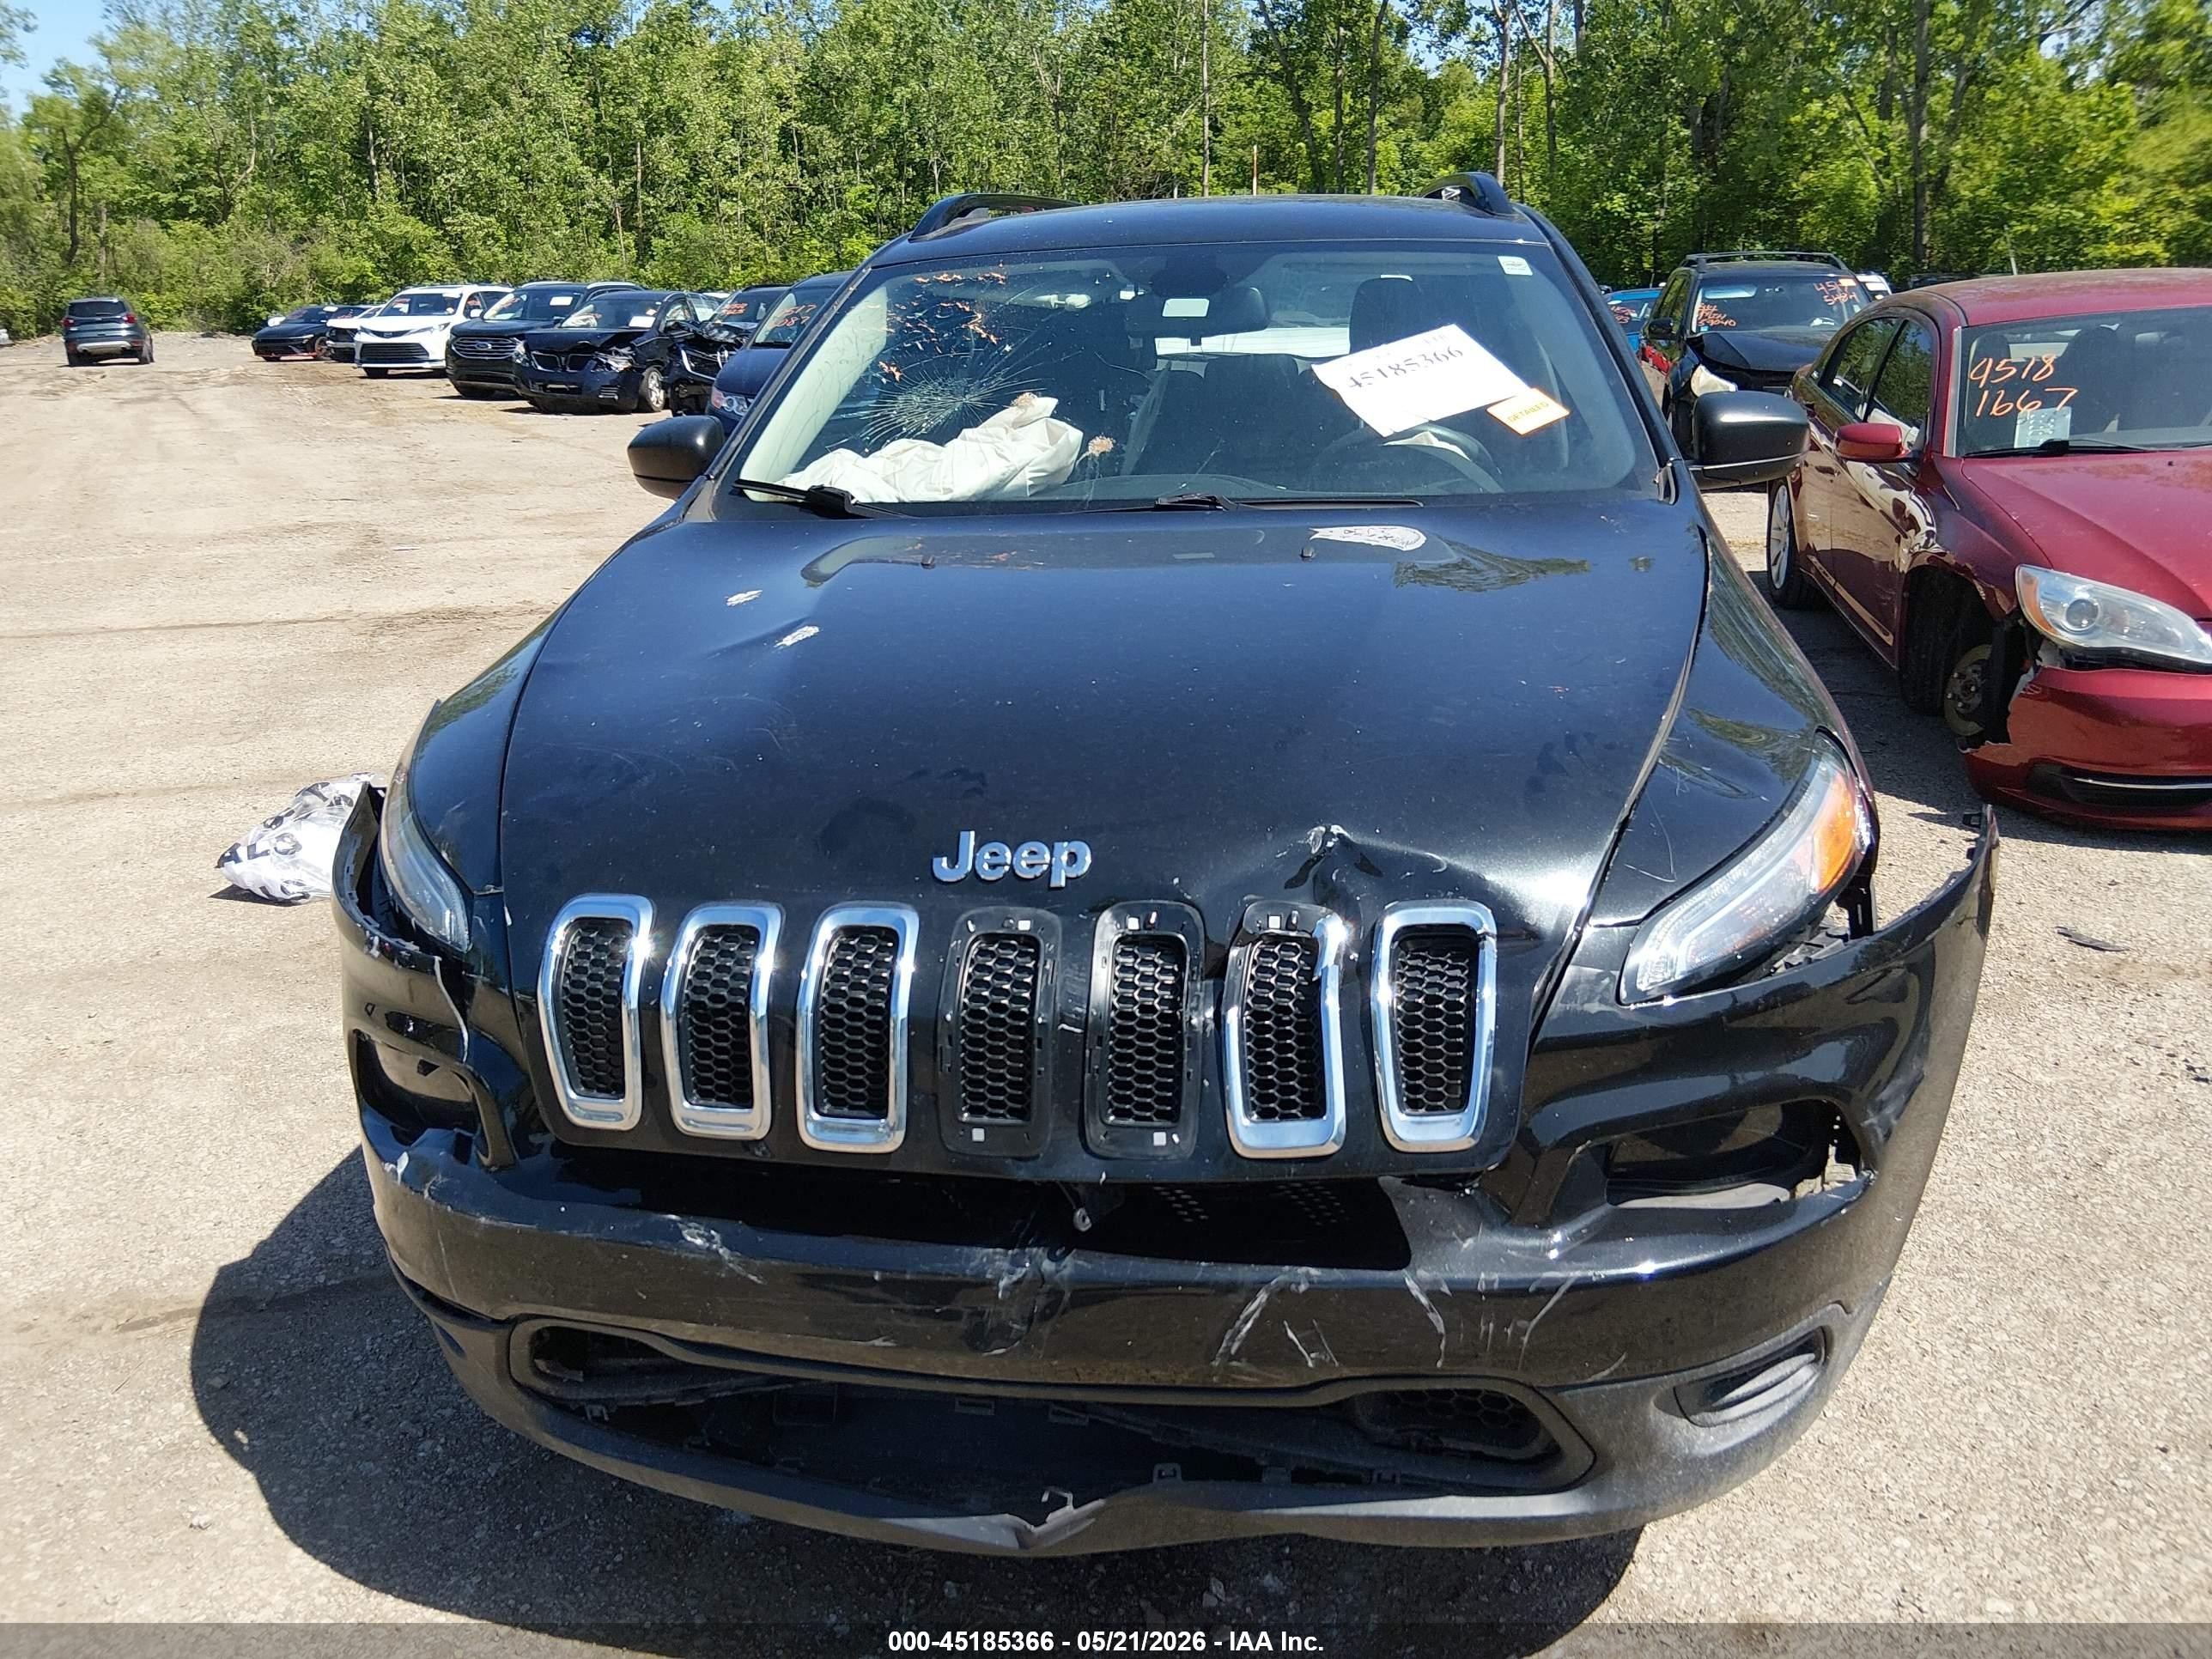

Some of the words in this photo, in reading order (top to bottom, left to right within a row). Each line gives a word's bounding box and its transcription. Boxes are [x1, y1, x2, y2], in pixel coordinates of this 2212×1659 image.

[1348, 347, 1463, 388] 45185366
[1976, 387, 2079, 417] 1667
[932, 830, 1091, 887] Jeep
